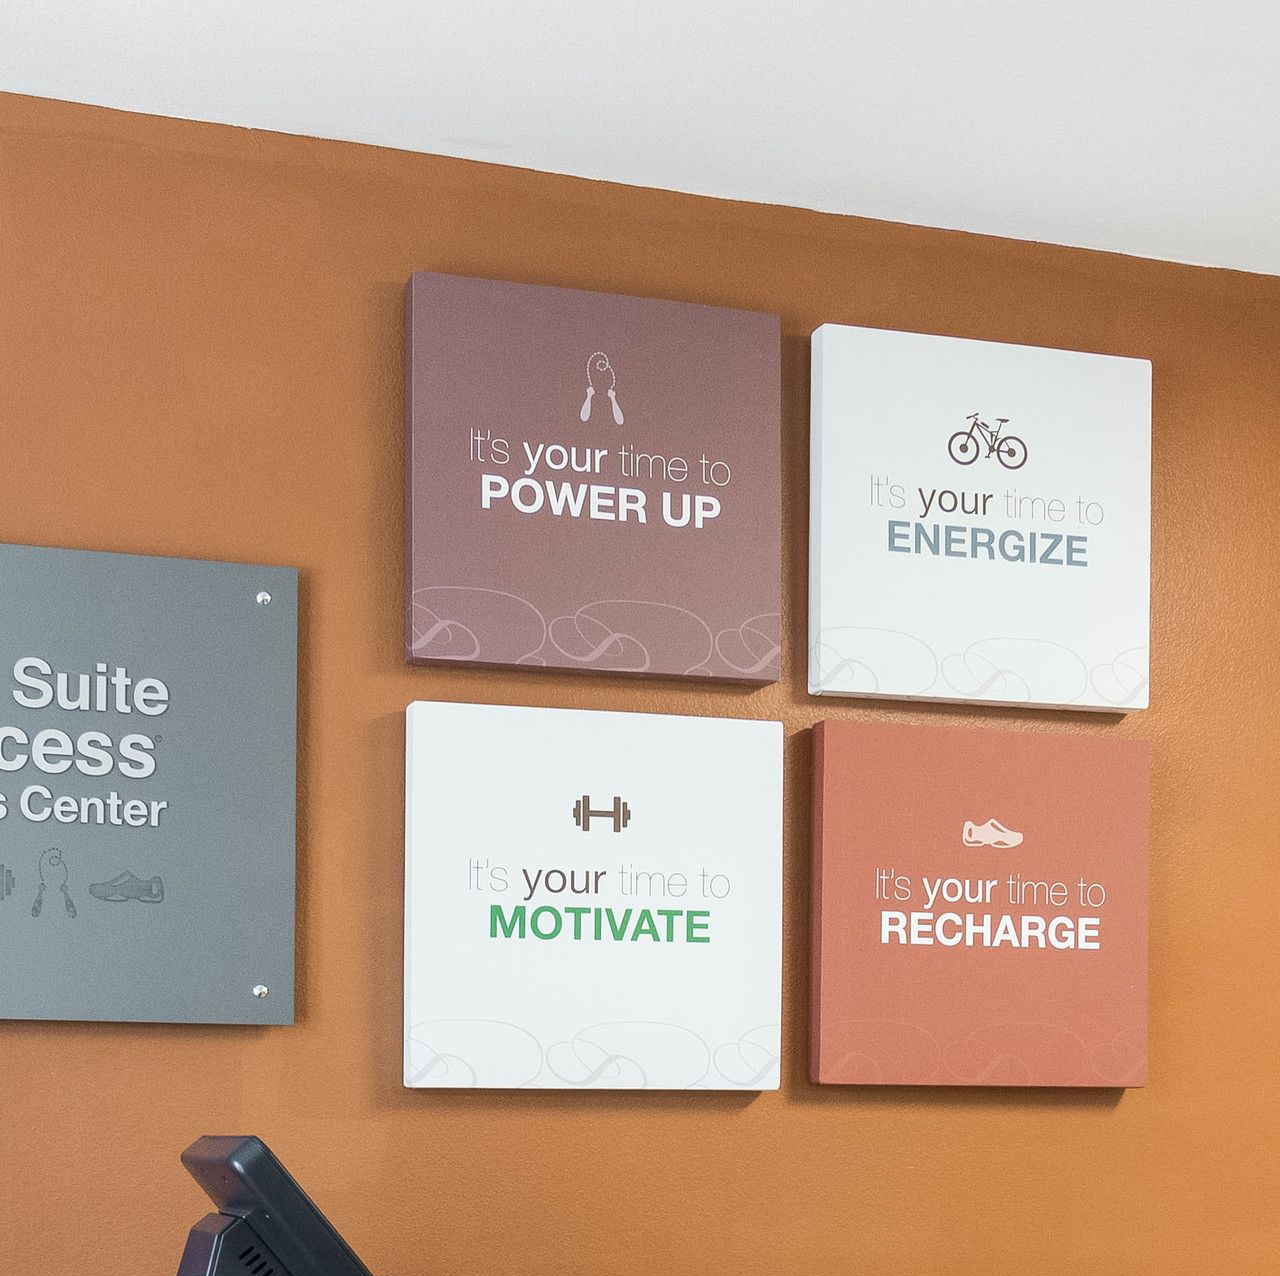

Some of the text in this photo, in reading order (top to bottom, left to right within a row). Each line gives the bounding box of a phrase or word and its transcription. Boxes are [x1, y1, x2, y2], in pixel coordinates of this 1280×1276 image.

[468, 427, 732, 486] It's your time to
[480, 474, 723, 530] POWER UP
[869, 474, 1105, 526] It's your time to
[887, 520, 1089, 568] ENERGIZE
[12, 656, 170, 717] Suite
[19, 784, 168, 828] Center
[467, 857, 731, 900] It's your time to
[875, 868, 1106, 910] It's your time to
[488, 904, 711, 944] MOTIVATE
[880, 910, 1101, 950] RECHARGE
